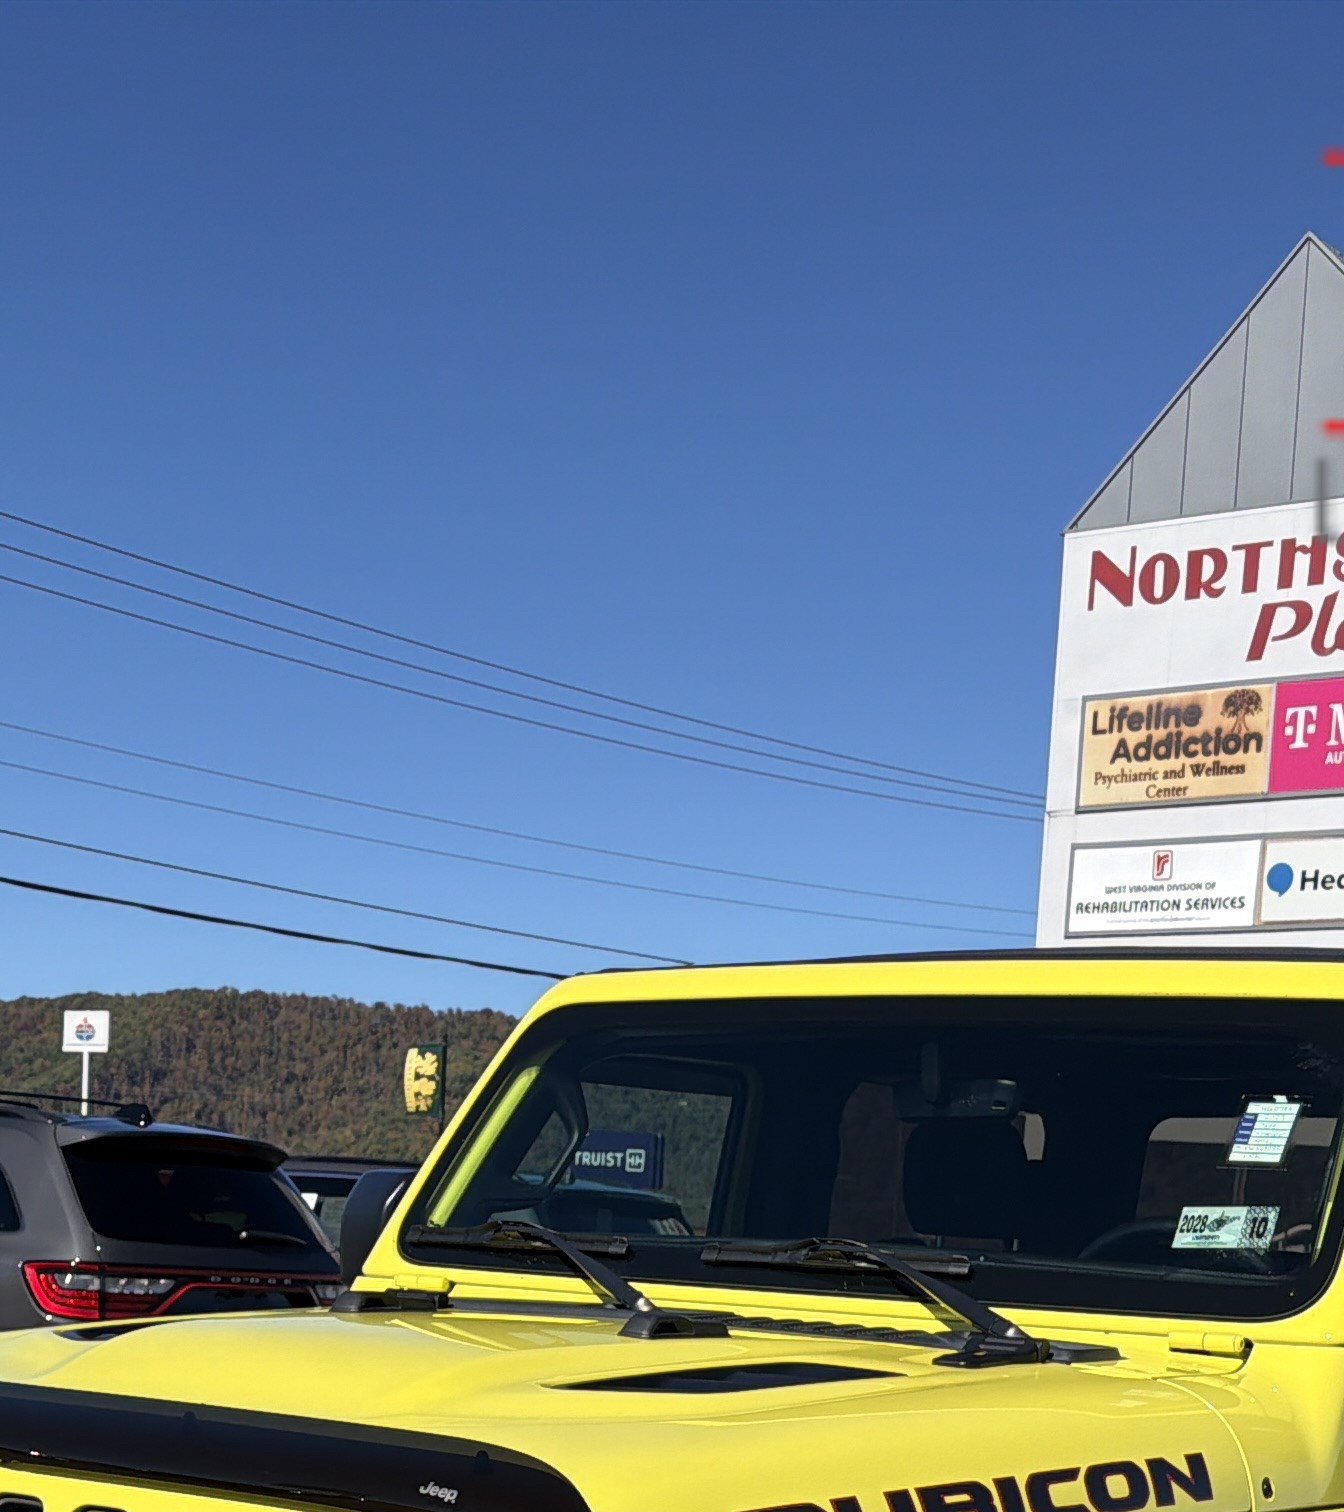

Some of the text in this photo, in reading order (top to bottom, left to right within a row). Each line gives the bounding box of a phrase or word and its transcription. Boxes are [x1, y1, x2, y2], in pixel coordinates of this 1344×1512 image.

[1092, 701, 1203, 735] Lifeline
[1110, 727, 1263, 765] Addiction
[1094, 760, 1246, 790] Psychiatric and Wellness
[1145, 784, 1189, 799] Center
[1075, 896, 1246, 914] REHABILITATION SERVICES
[575, 1151, 624, 1167] TRUIST
[1179, 1215, 1269, 1239] 2028 10
[419, 1481, 458, 1504] Jeep
